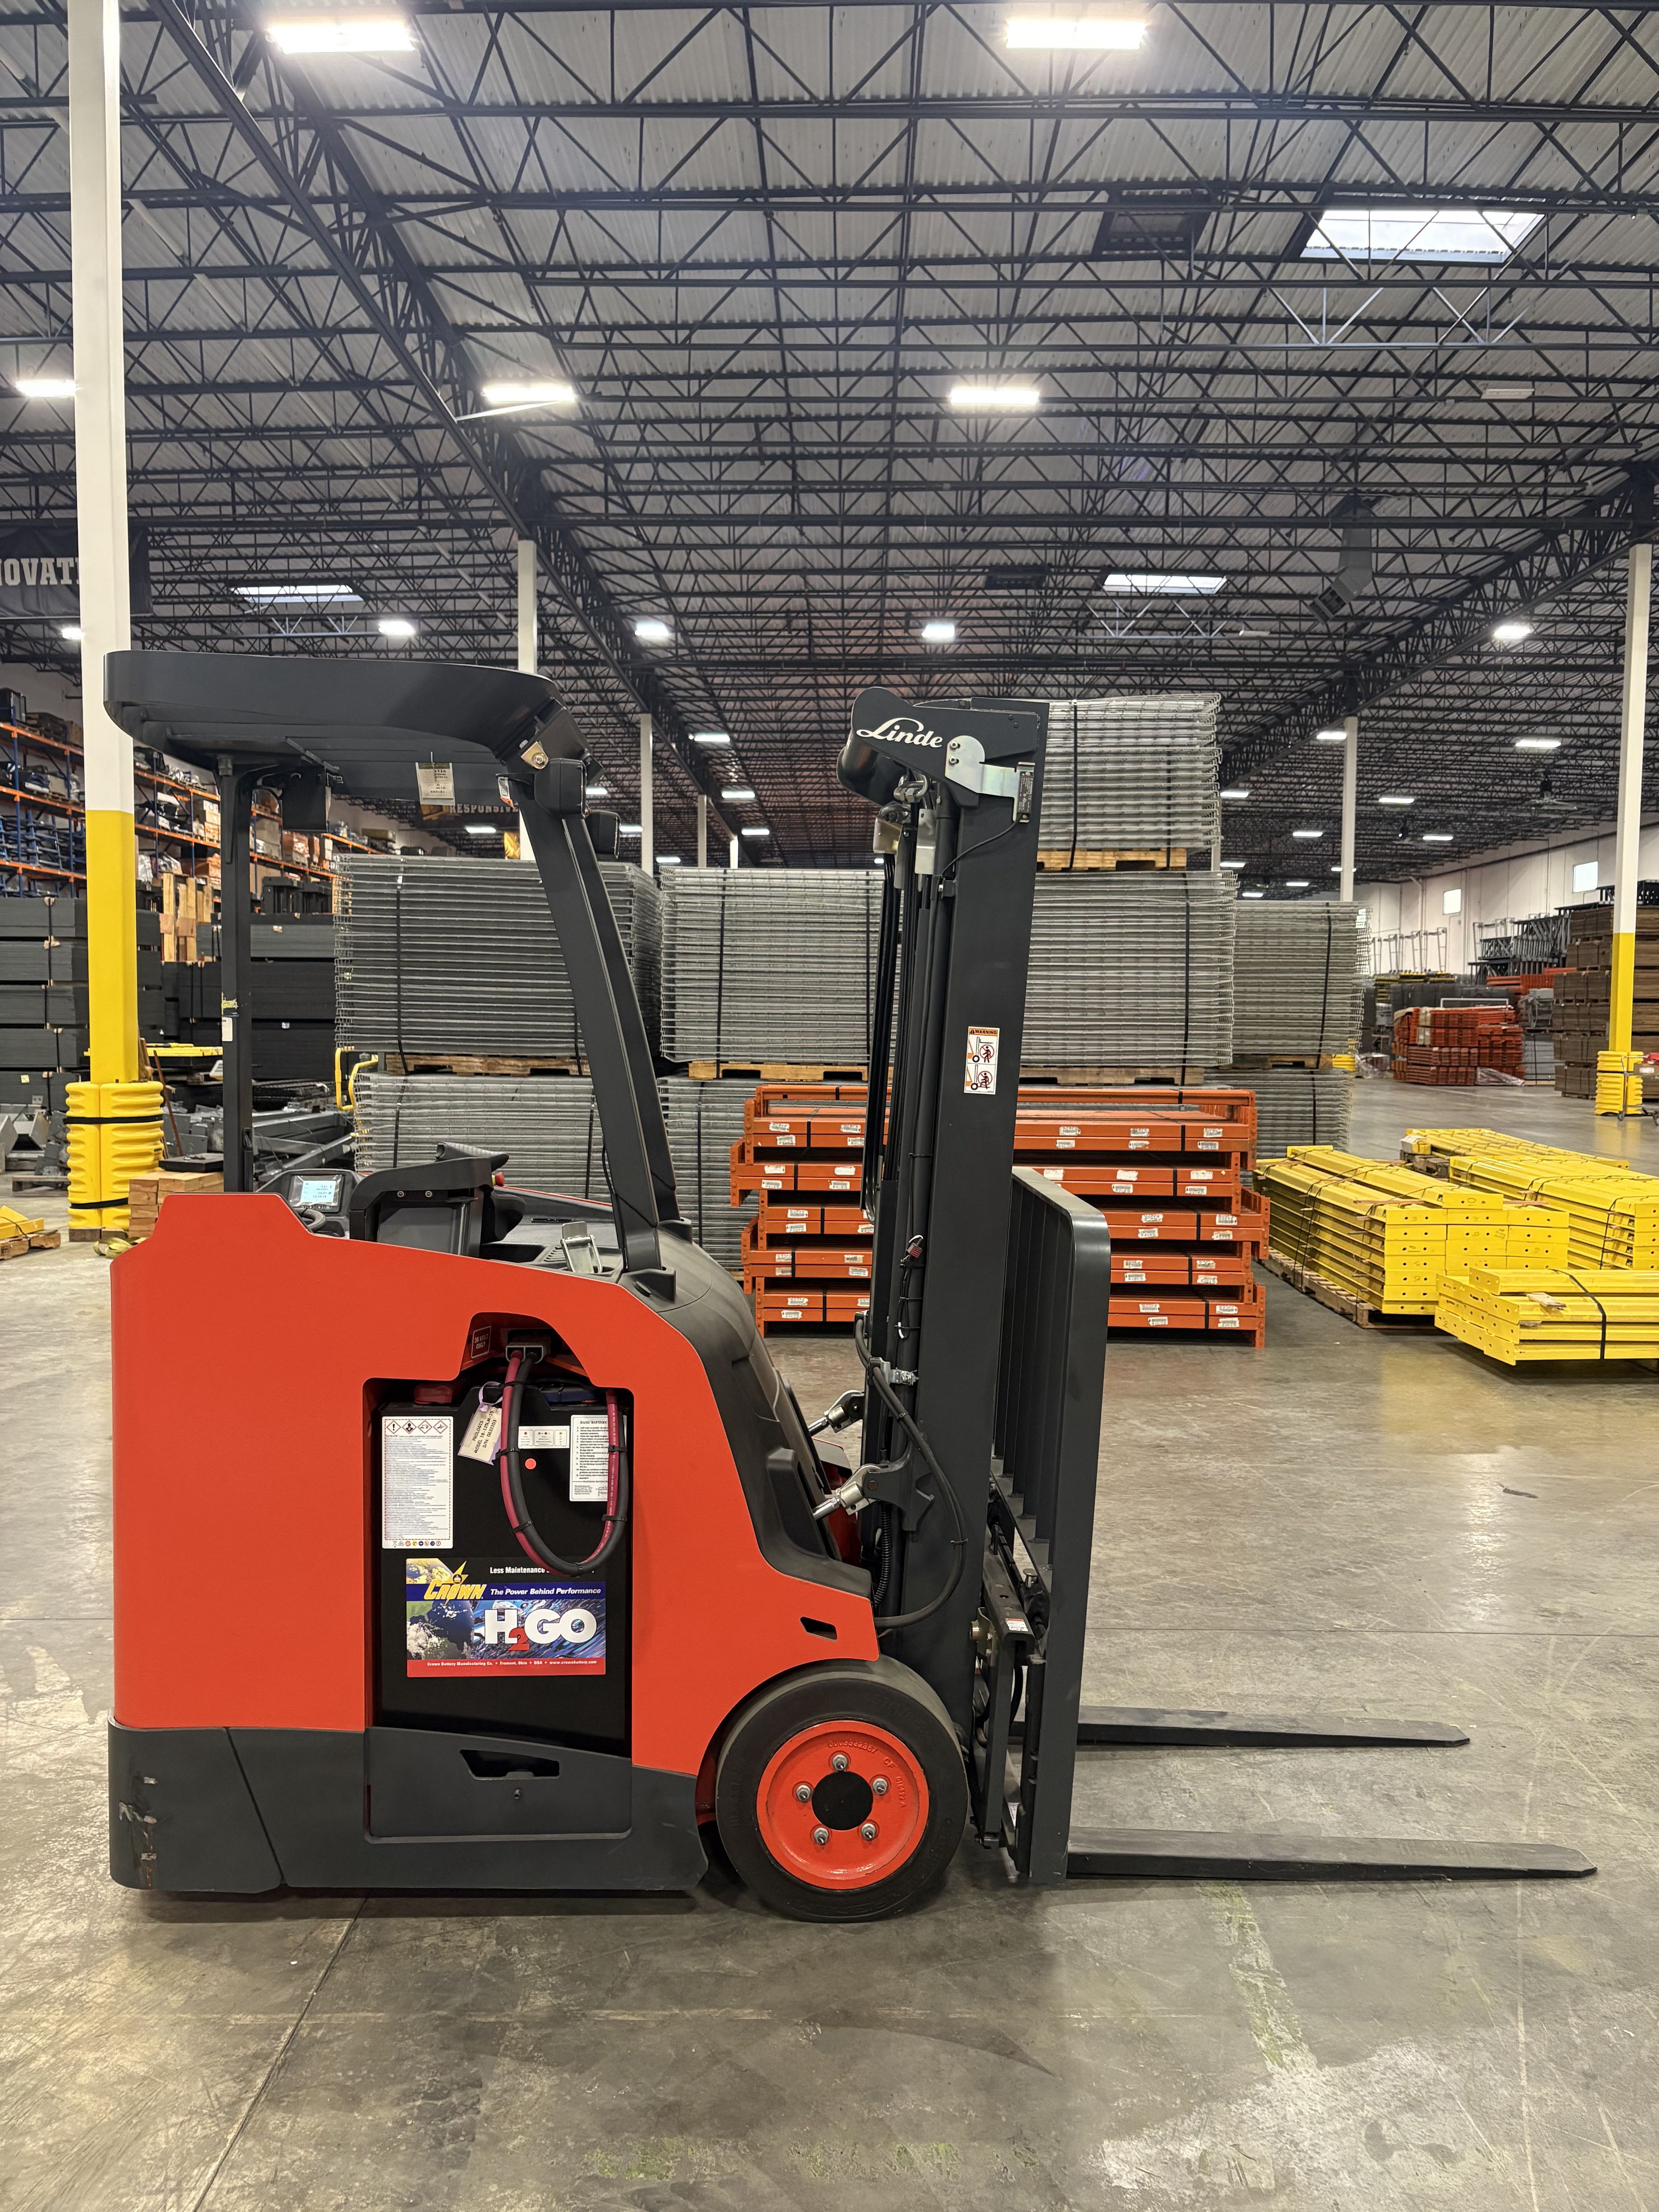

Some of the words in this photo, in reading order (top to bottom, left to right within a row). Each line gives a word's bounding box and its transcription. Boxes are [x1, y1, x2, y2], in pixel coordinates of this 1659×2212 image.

[0, 557, 79, 586] OVAT
[856, 718, 943, 748] Linde
[472, 1421, 483, 1441] PROLOGIS
[474, 1440, 483, 1453] MODEL
[424, 1579, 487, 1600] CROWN
[484, 1608, 597, 1651] H2GO
